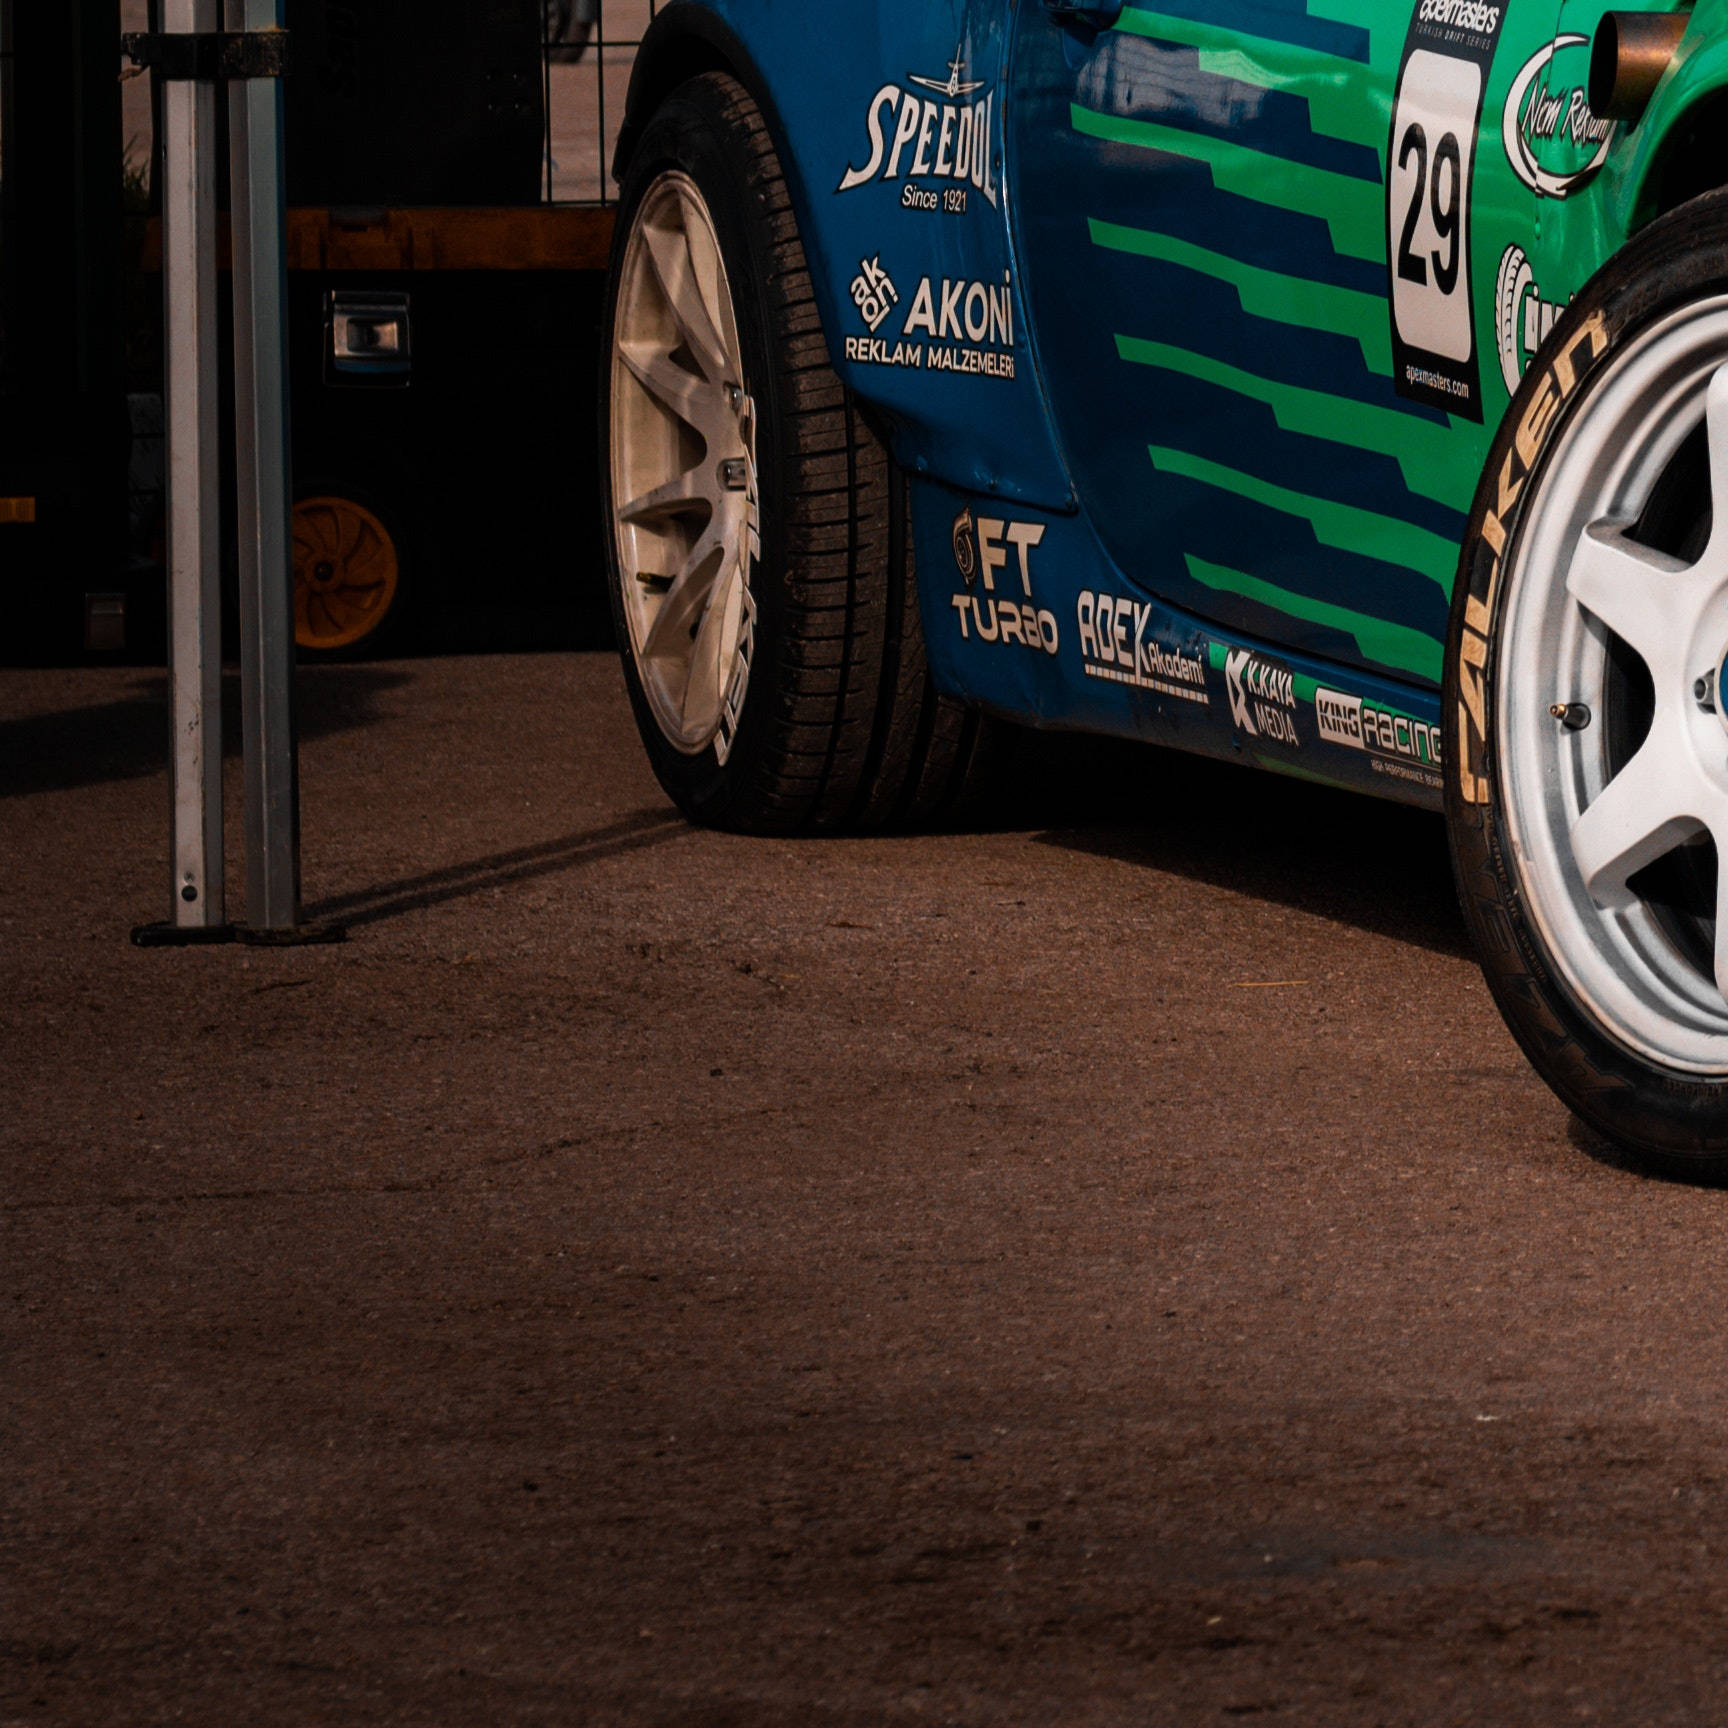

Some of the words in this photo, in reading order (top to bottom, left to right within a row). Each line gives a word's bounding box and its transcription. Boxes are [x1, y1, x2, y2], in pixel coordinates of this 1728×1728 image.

[836, 83, 998, 210] SPEEDOL
[901, 184, 939, 210] Since
[942, 189, 968, 213] 1921
[1398, 123, 1462, 296] 29
[845, 337, 923, 368] REKLAM
[927, 345, 1016, 380] MALZEMELERİ
[1405, 363, 1470, 400] apexmasters.com
[1458, 309, 1609, 805] FALKEN
[952, 594, 1059, 657] TURBO
[1147, 641, 1207, 686] Akademi
[1254, 701, 1300, 747] MEDIA
[1318, 699, 1360, 738] KING
